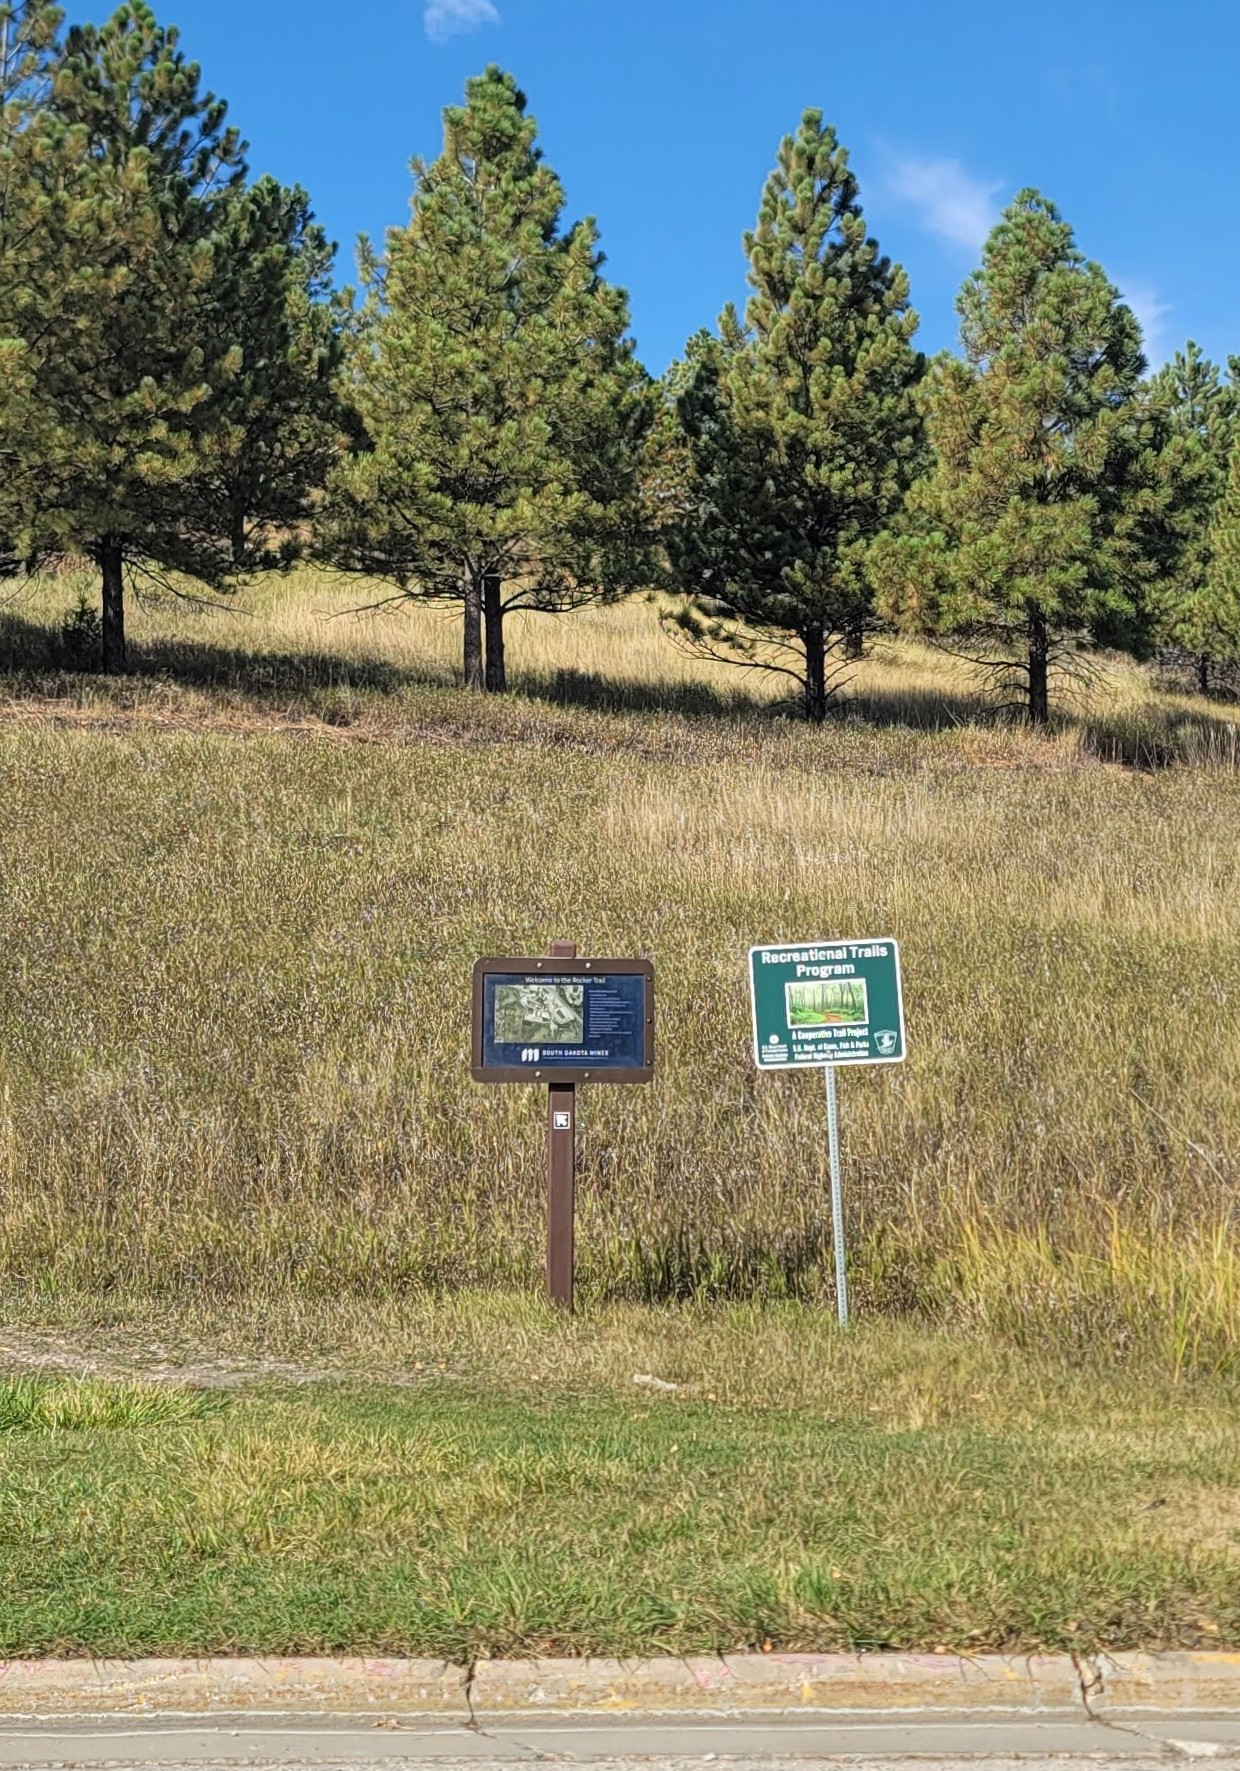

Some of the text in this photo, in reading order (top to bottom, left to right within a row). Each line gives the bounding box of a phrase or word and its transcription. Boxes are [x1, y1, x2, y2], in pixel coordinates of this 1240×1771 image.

[761, 945, 888, 964] Recreational Trails
[796, 964, 855, 978] Program
[791, 1027, 869, 1041] A Cooperative Trail Project
[839, 1041, 850, 1049] Fish
[855, 1040, 870, 1048] Parks
